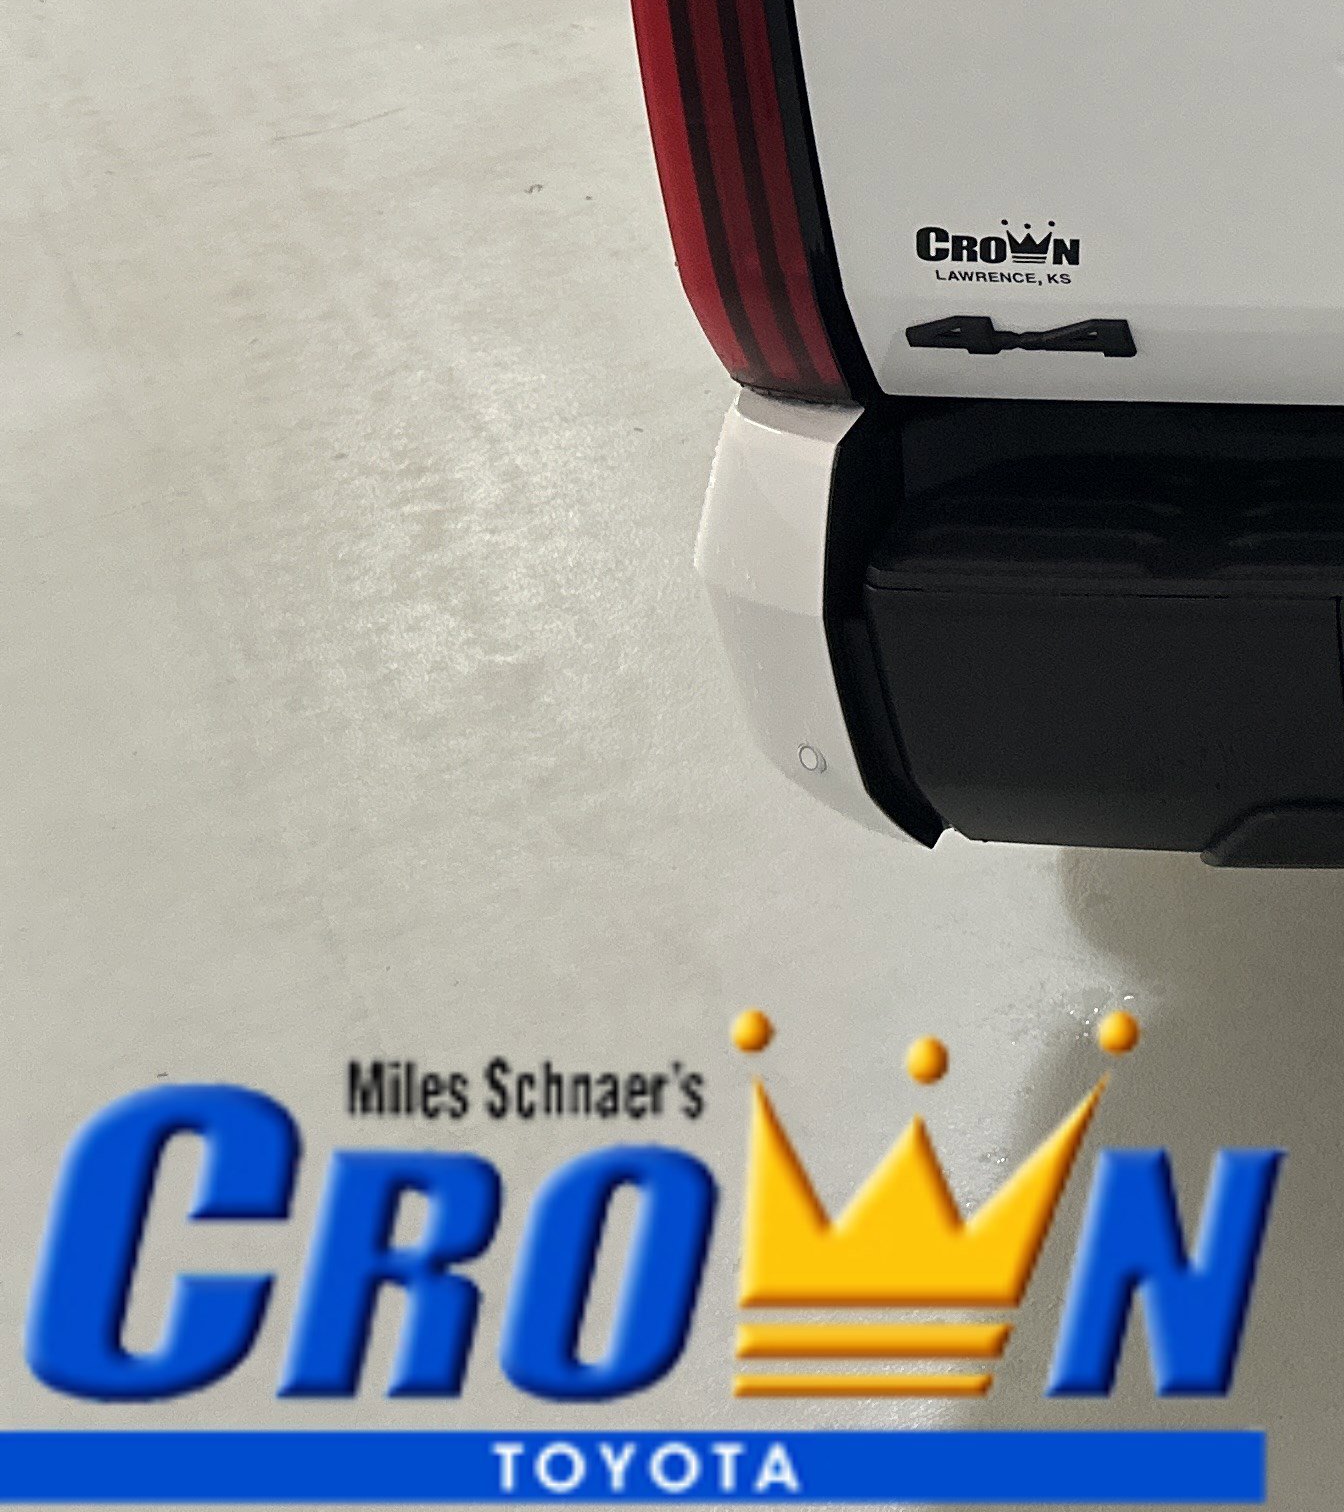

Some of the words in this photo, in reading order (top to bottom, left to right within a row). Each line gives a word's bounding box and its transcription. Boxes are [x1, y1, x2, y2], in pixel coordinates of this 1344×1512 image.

[916, 219, 1080, 265] CROWN
[935, 269, 1043, 286] LAWRENCE,
[1047, 273, 1072, 284] KS
